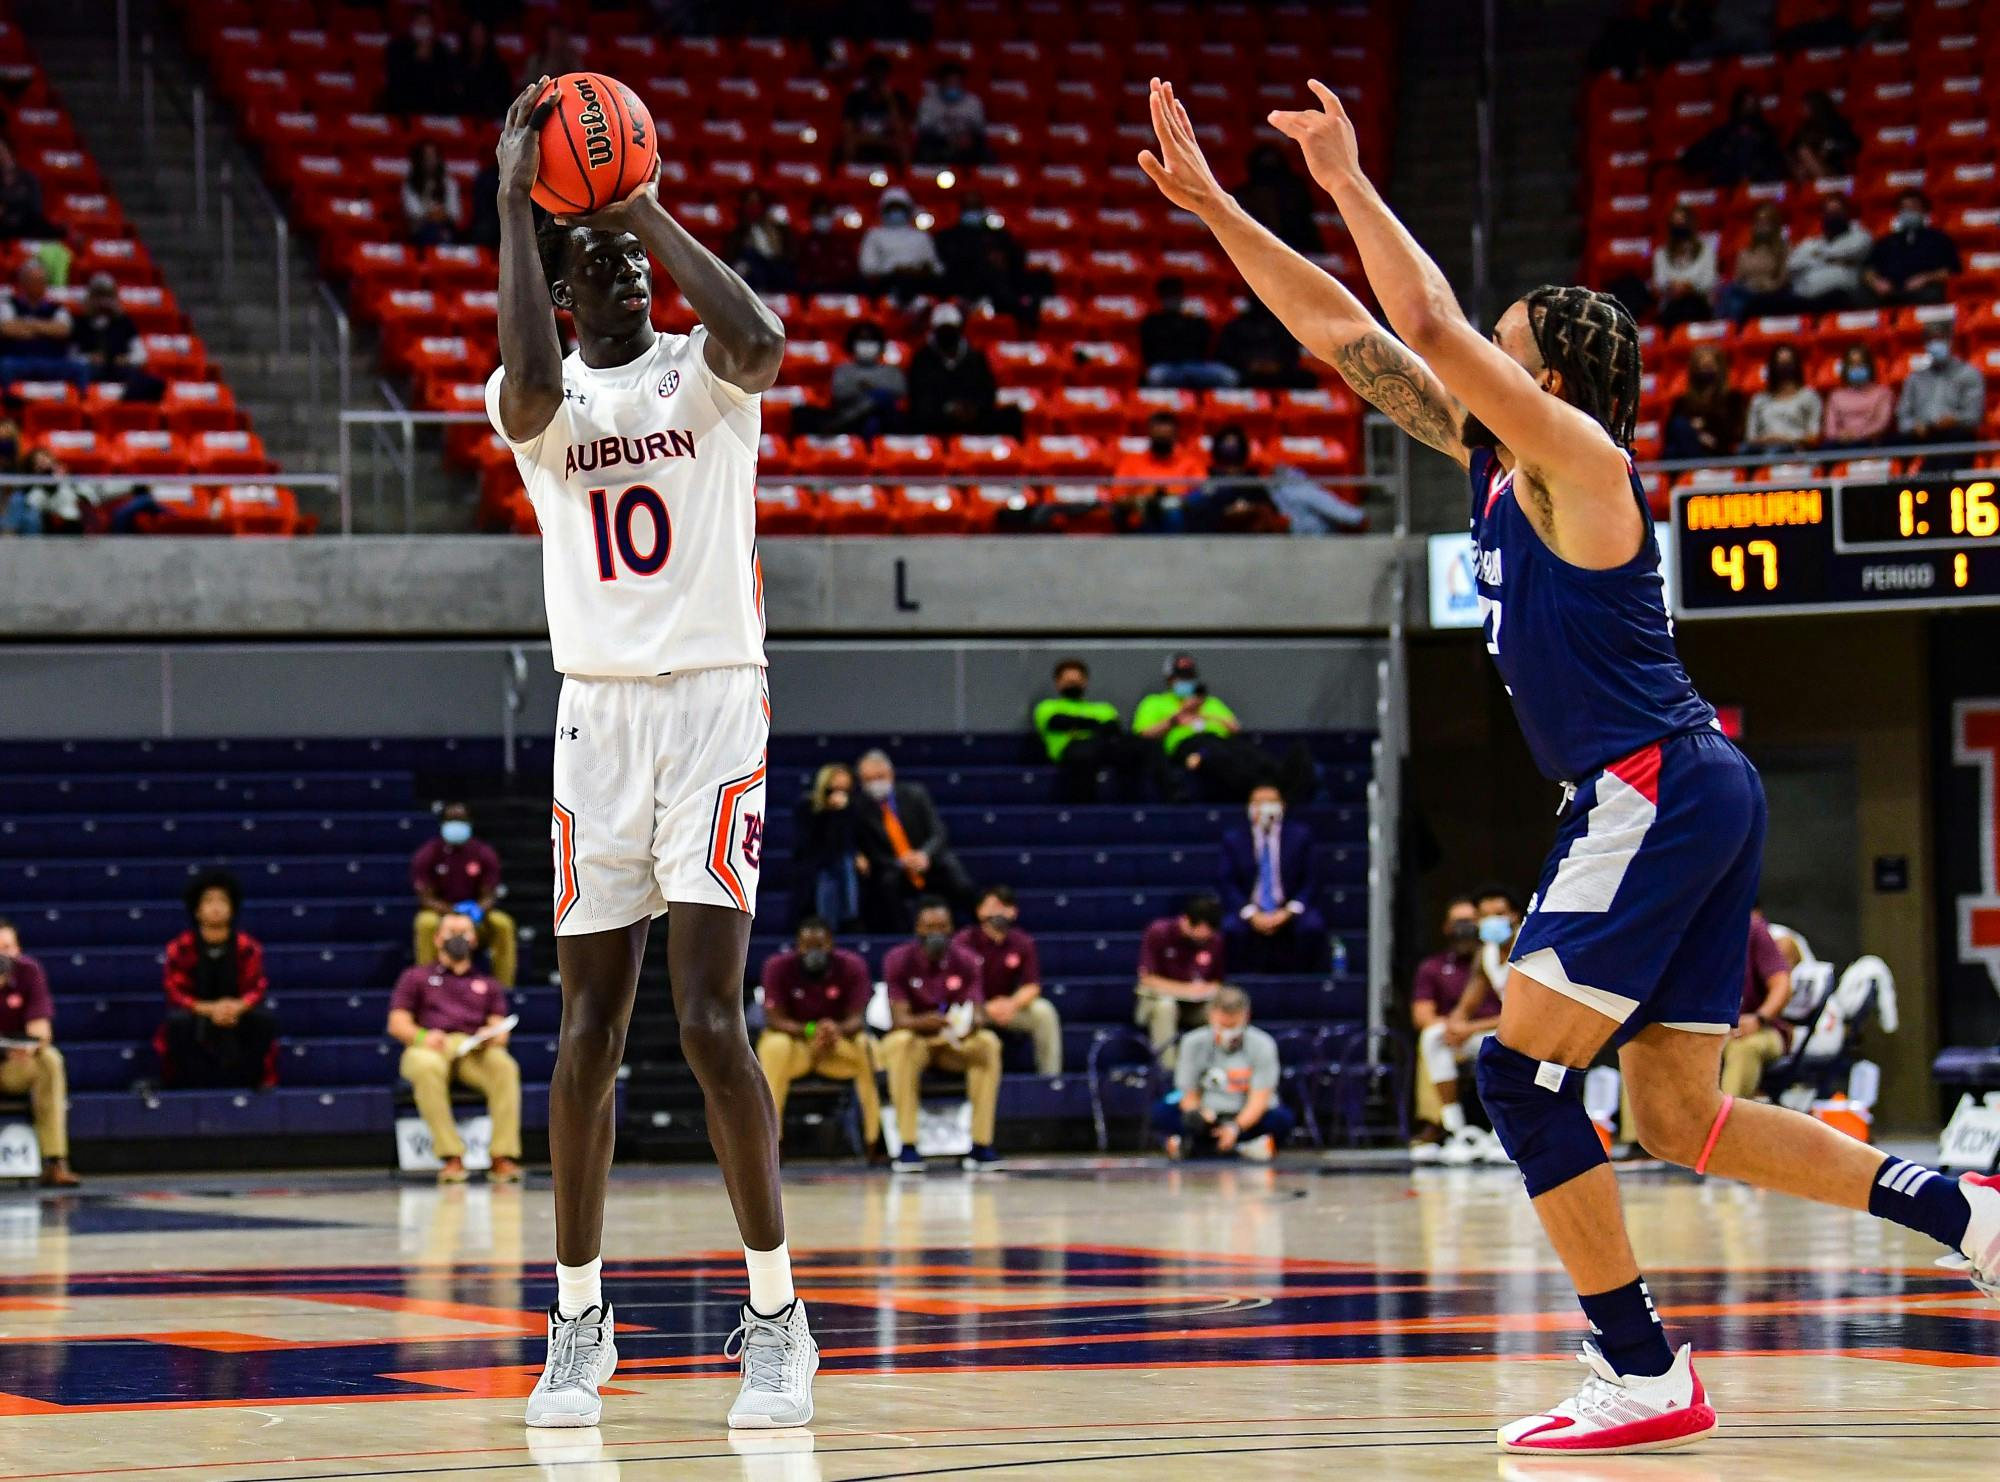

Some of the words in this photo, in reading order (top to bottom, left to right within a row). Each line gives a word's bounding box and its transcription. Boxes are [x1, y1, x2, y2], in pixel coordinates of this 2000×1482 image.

[574, 78, 613, 170] Wilson
[660, 371, 678, 396] SEC
[565, 429, 697, 481] AUBURN
[589, 485, 671, 582] 10
[1687, 490, 1822, 530] AUBURN
[895, 557, 920, 612] L
[1711, 540, 1777, 592] 47
[1862, 562, 1935, 591] PERIOD
[1954, 553, 1968, 588] 1
